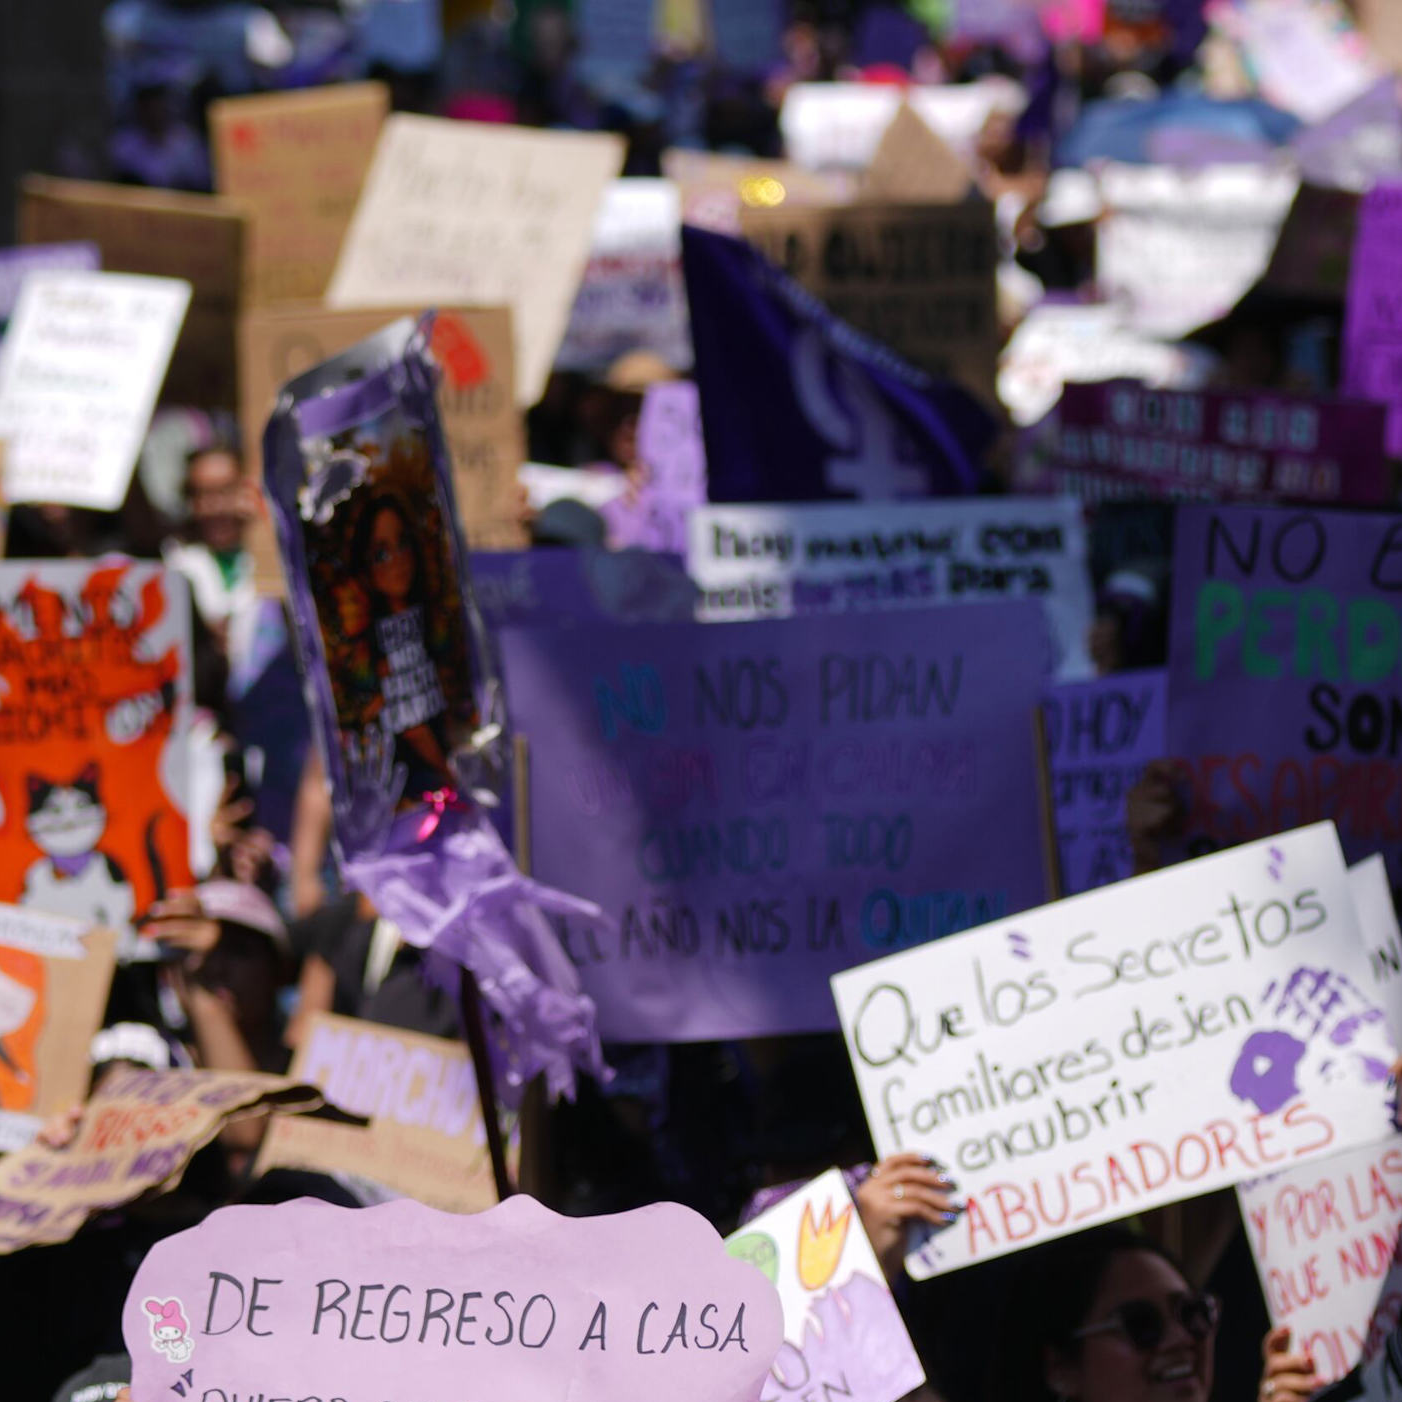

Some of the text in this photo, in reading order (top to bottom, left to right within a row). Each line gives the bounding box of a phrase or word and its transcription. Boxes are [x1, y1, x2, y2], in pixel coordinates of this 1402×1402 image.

[1204, 512, 1328, 584] NO
[595, 651, 963, 738] NO NOS PIDAN
[716, 897, 791, 957] NOS
[851, 982, 976, 1070] Que
[975, 958, 1058, 1029] los
[880, 994, 1255, 1148] familiares dejen
[955, 1079, 1158, 1173] encubrir
[959, 1102, 1336, 1258] ABUSADORES
[1250, 1203, 1268, 1261] Y
[1274, 1178, 1347, 1247] POR
[198, 1270, 752, 1356] DE REGRESO A CASA
[1266, 1254, 1330, 1319] QUE
